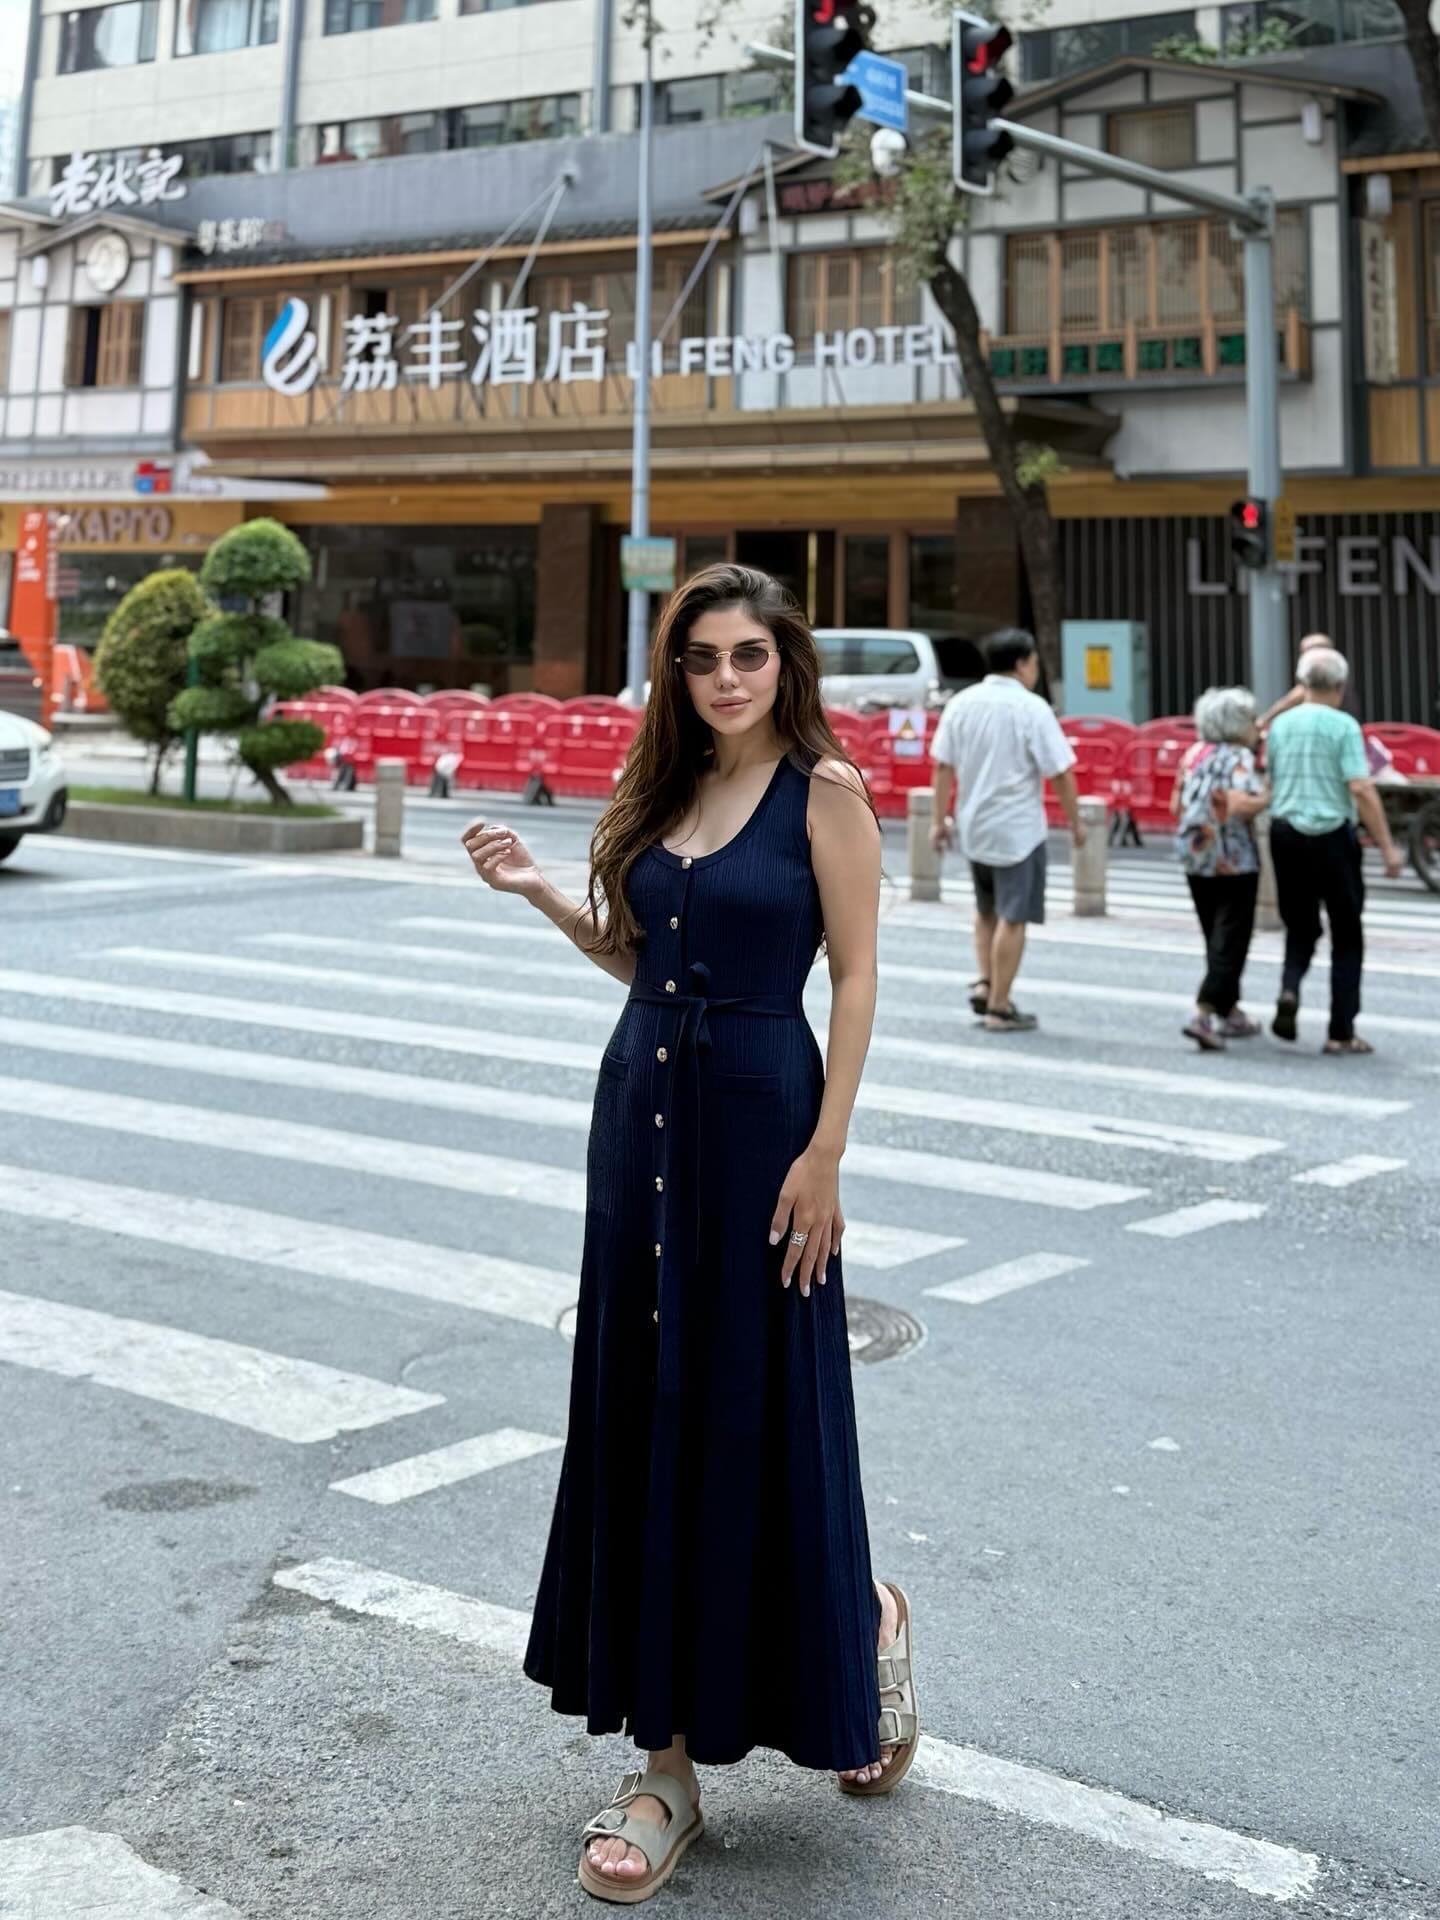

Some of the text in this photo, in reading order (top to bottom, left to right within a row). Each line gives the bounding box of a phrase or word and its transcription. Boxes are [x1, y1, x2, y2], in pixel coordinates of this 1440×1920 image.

[341, 302, 610, 392] 荔丰酒店
[626, 326, 957, 379] LI FENG HOTEL
